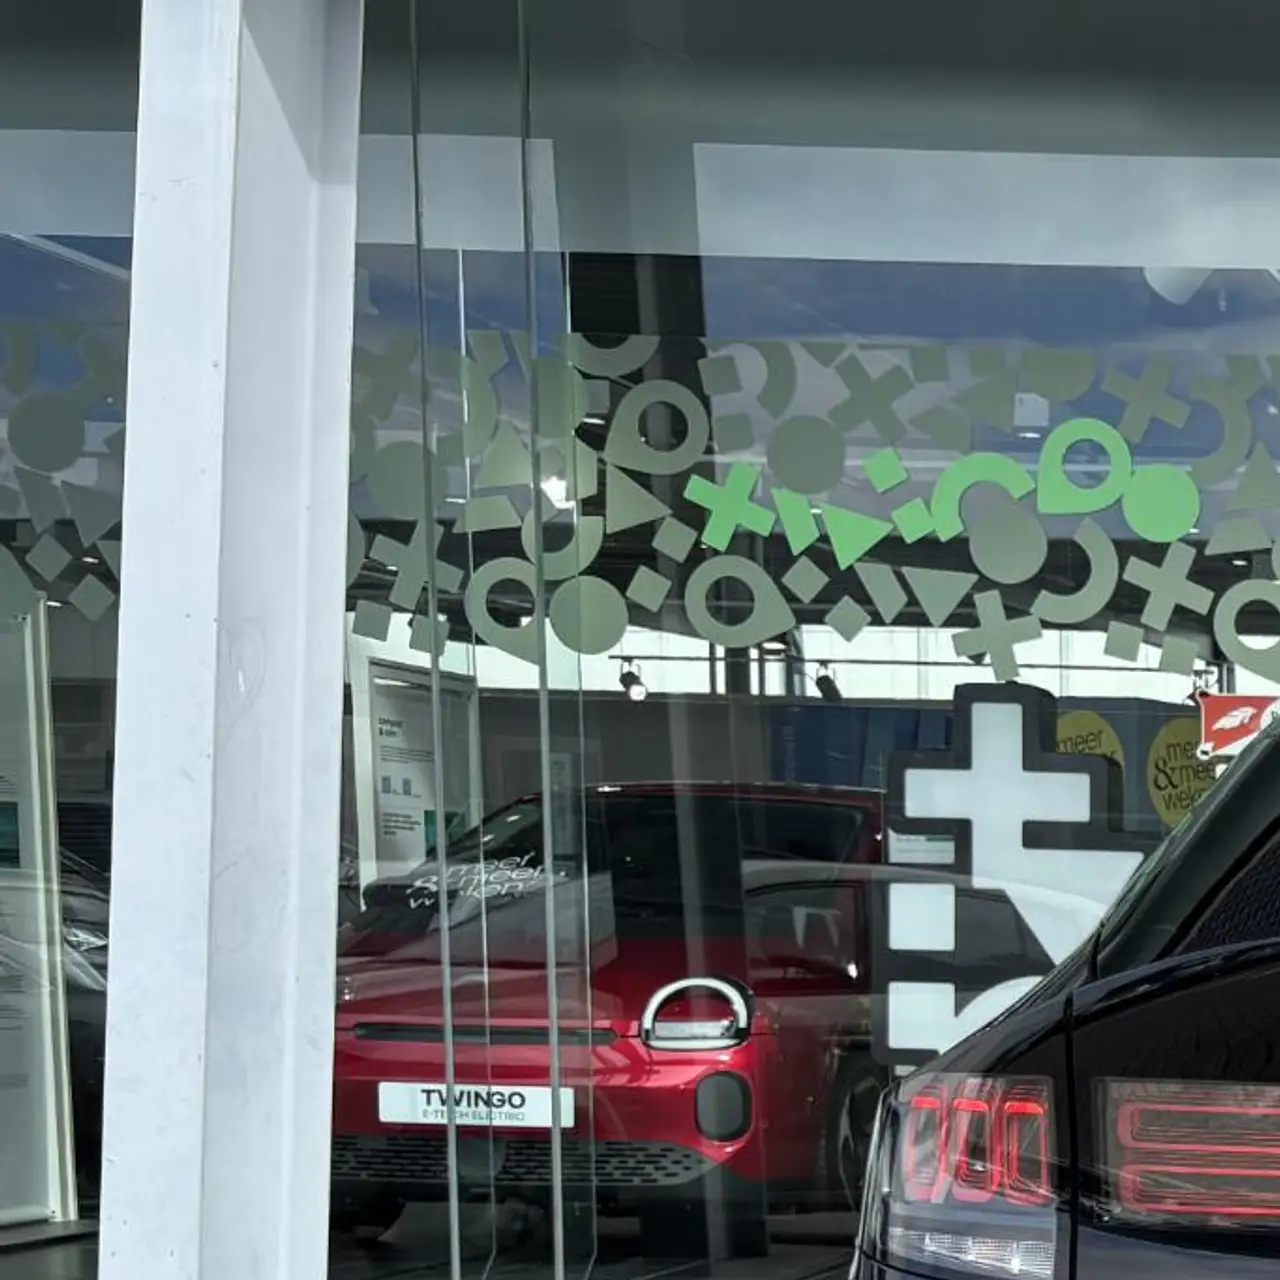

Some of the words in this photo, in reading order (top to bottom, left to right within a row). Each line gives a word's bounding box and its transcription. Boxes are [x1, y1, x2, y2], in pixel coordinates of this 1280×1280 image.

[1153, 757, 1178, 791] &
[1180, 762, 1216, 784] mee
[421, 1089, 526, 1109] TWINGO
